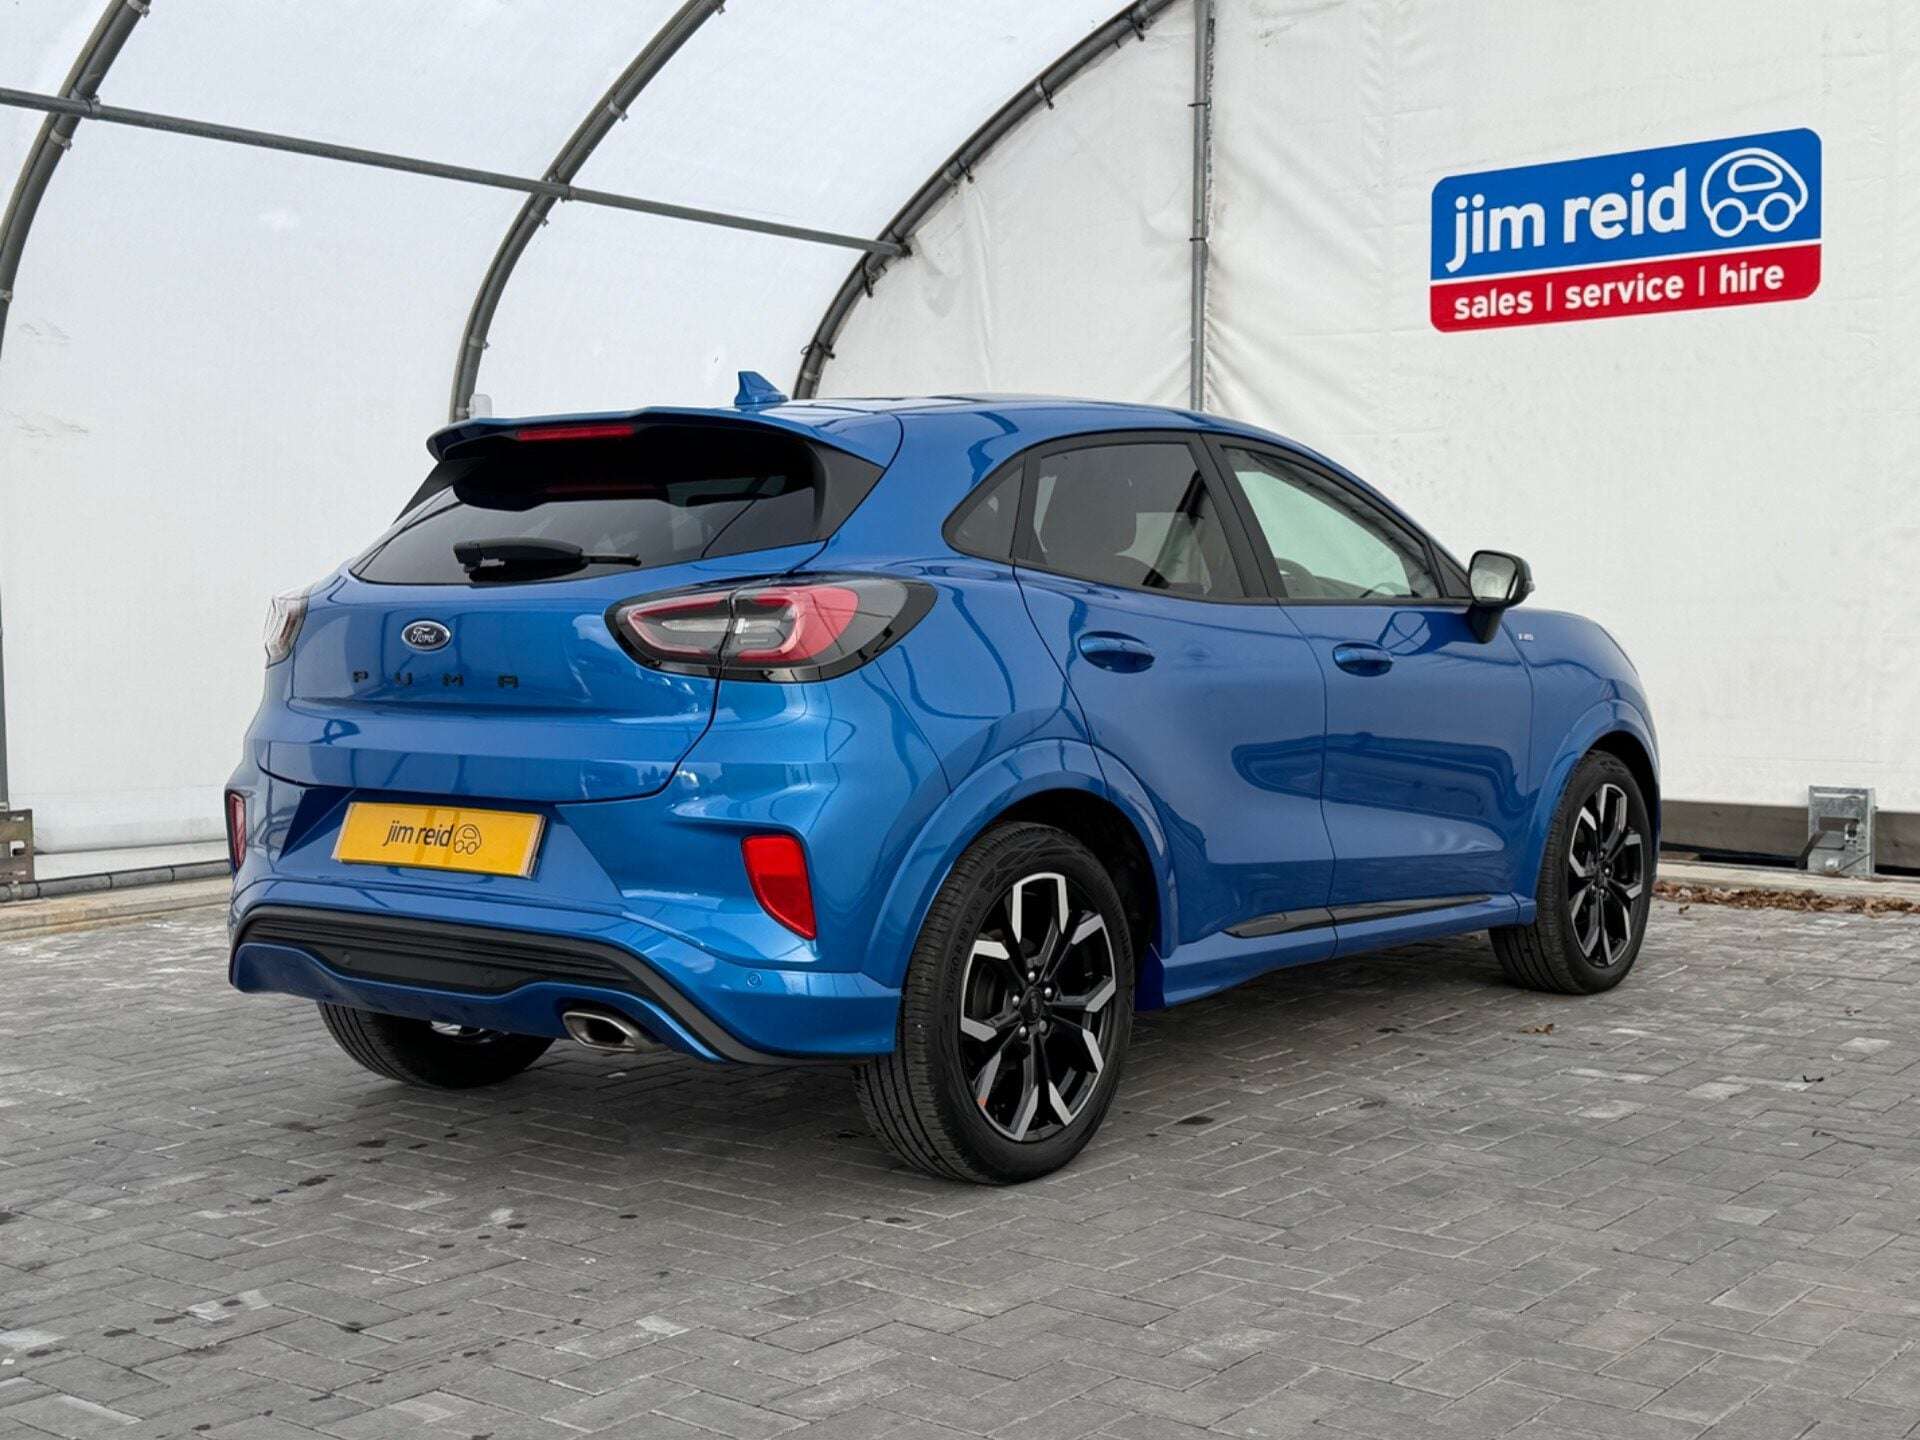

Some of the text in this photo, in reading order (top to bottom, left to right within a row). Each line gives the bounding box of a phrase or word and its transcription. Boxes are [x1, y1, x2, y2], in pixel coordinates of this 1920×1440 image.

[1445, 167, 1687, 273] jim reid
[1454, 262, 1785, 321] sales service hire
[410, 626, 437, 644] Ford
[352, 670, 520, 689] PUMA
[382, 819, 454, 848] jim reid
